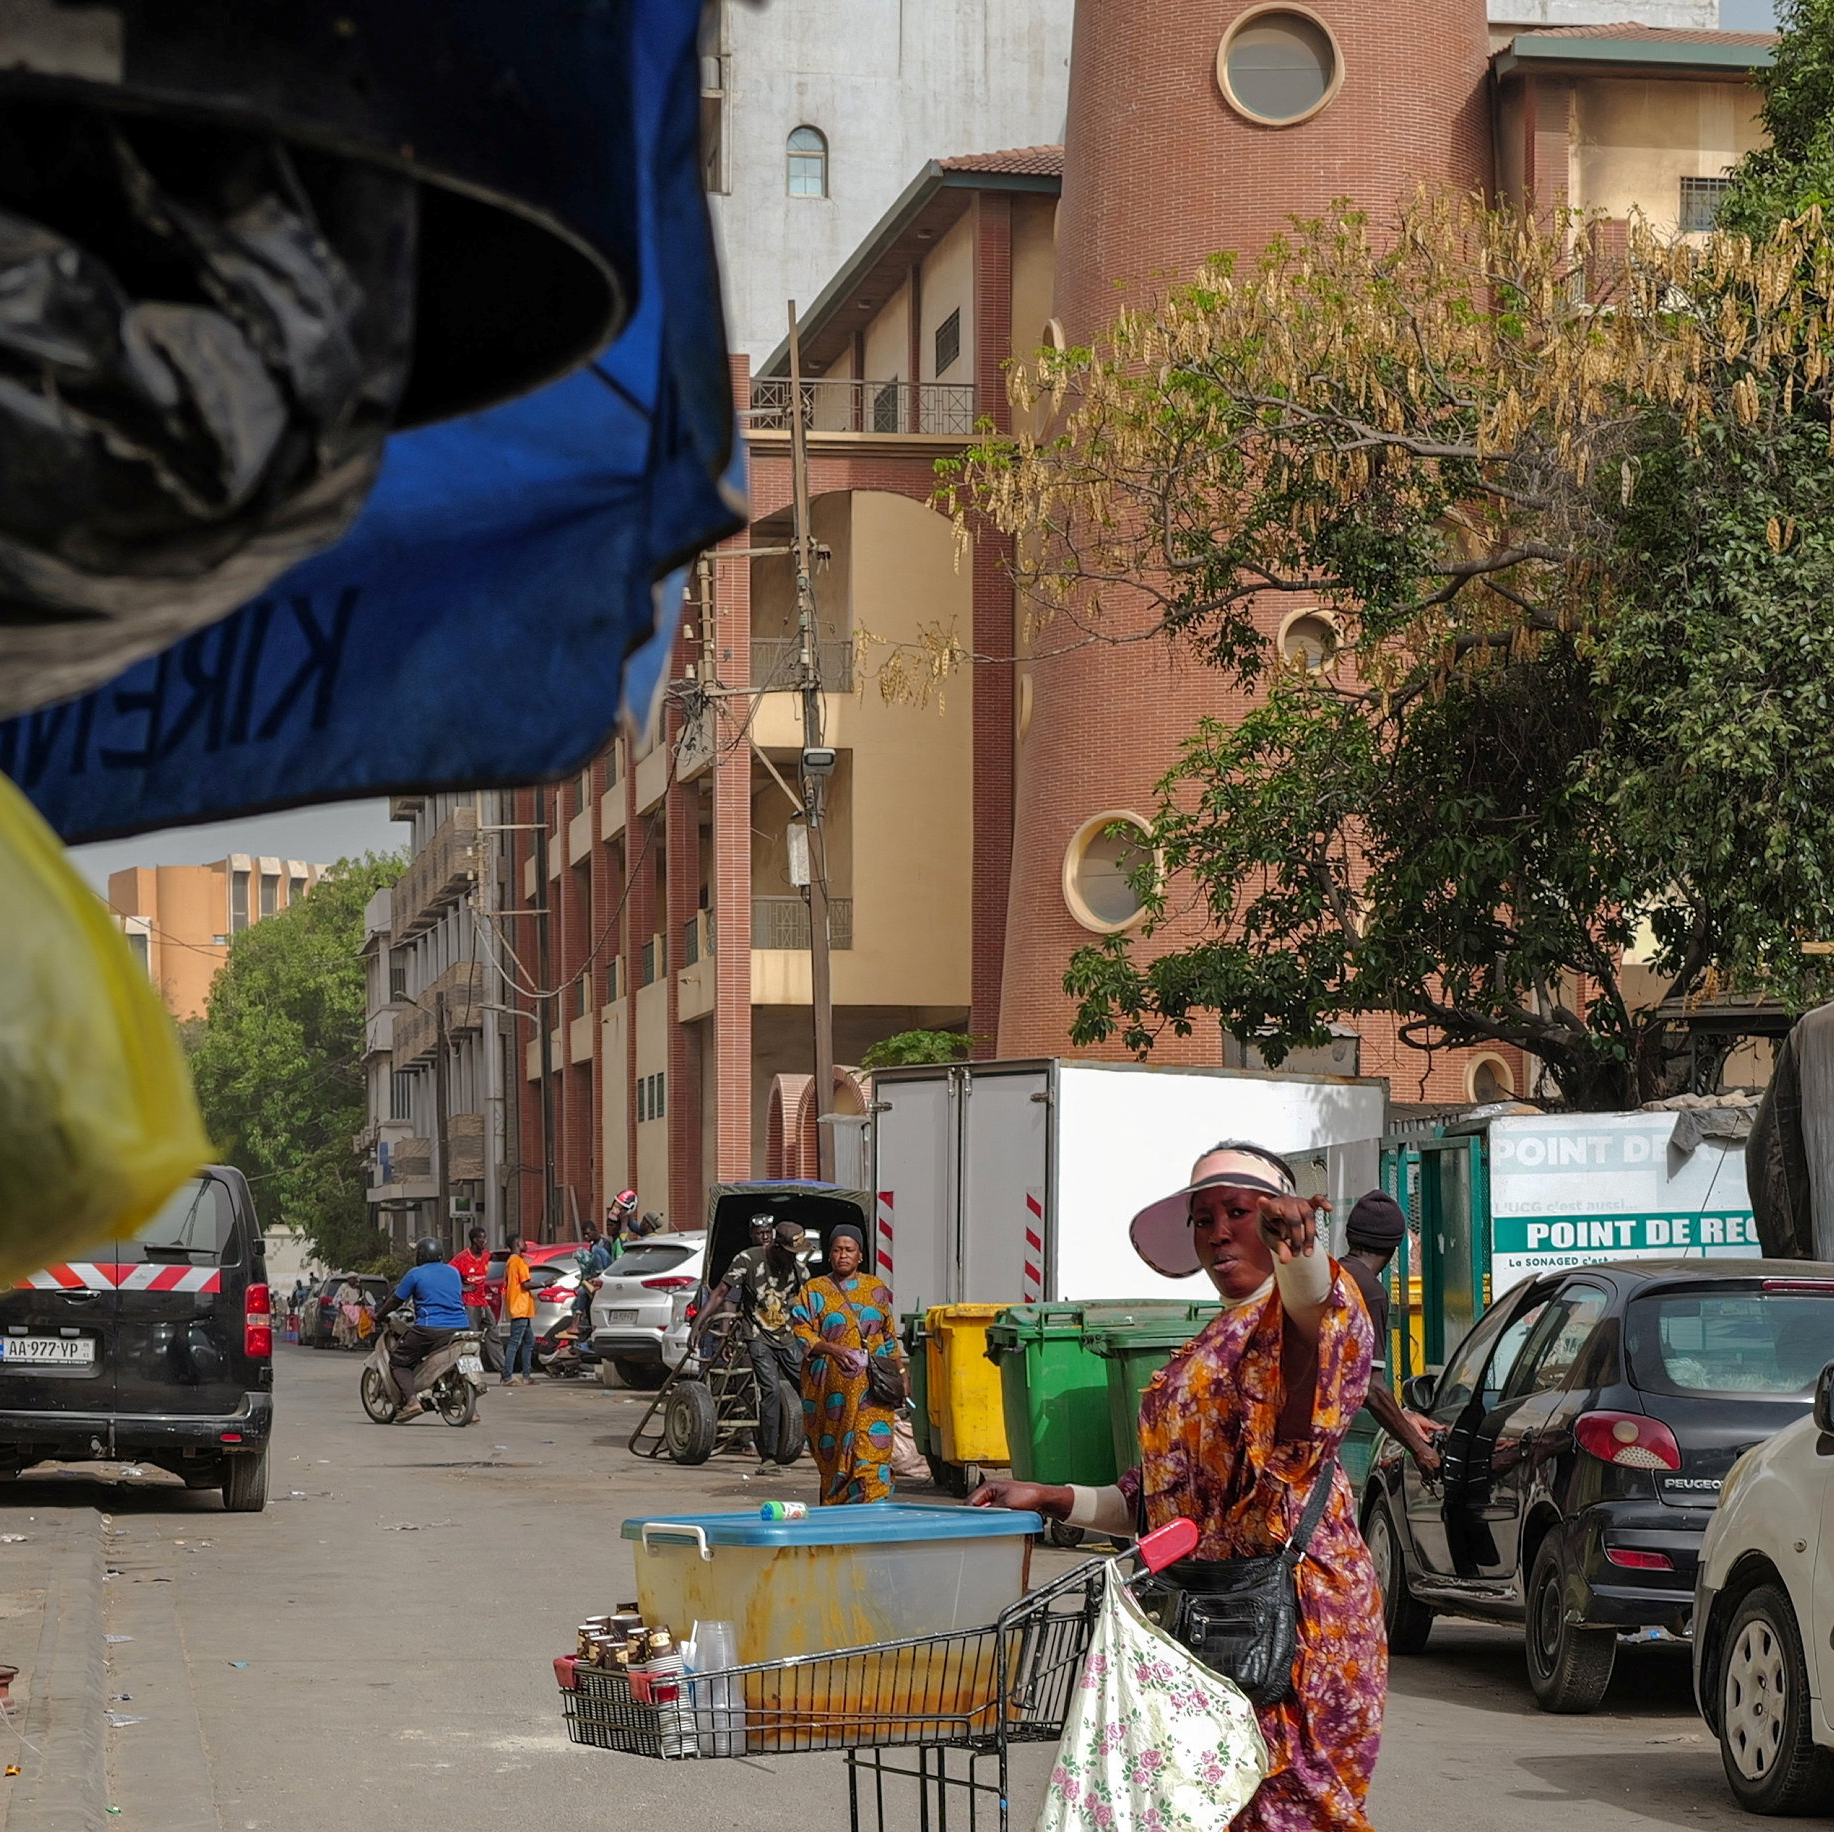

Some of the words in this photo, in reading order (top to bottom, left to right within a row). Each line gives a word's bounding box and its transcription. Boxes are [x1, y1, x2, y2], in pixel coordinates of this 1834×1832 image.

[1498, 1136, 1614, 1168] POINT
[1527, 1220, 1637, 1249] POINT
[1646, 1218, 1691, 1246] DE
[1509, 1258, 1522, 1268] La
[1525, 1256, 1579, 1267] SONAGED
[1664, 1478, 1724, 1490] PEUGEO
